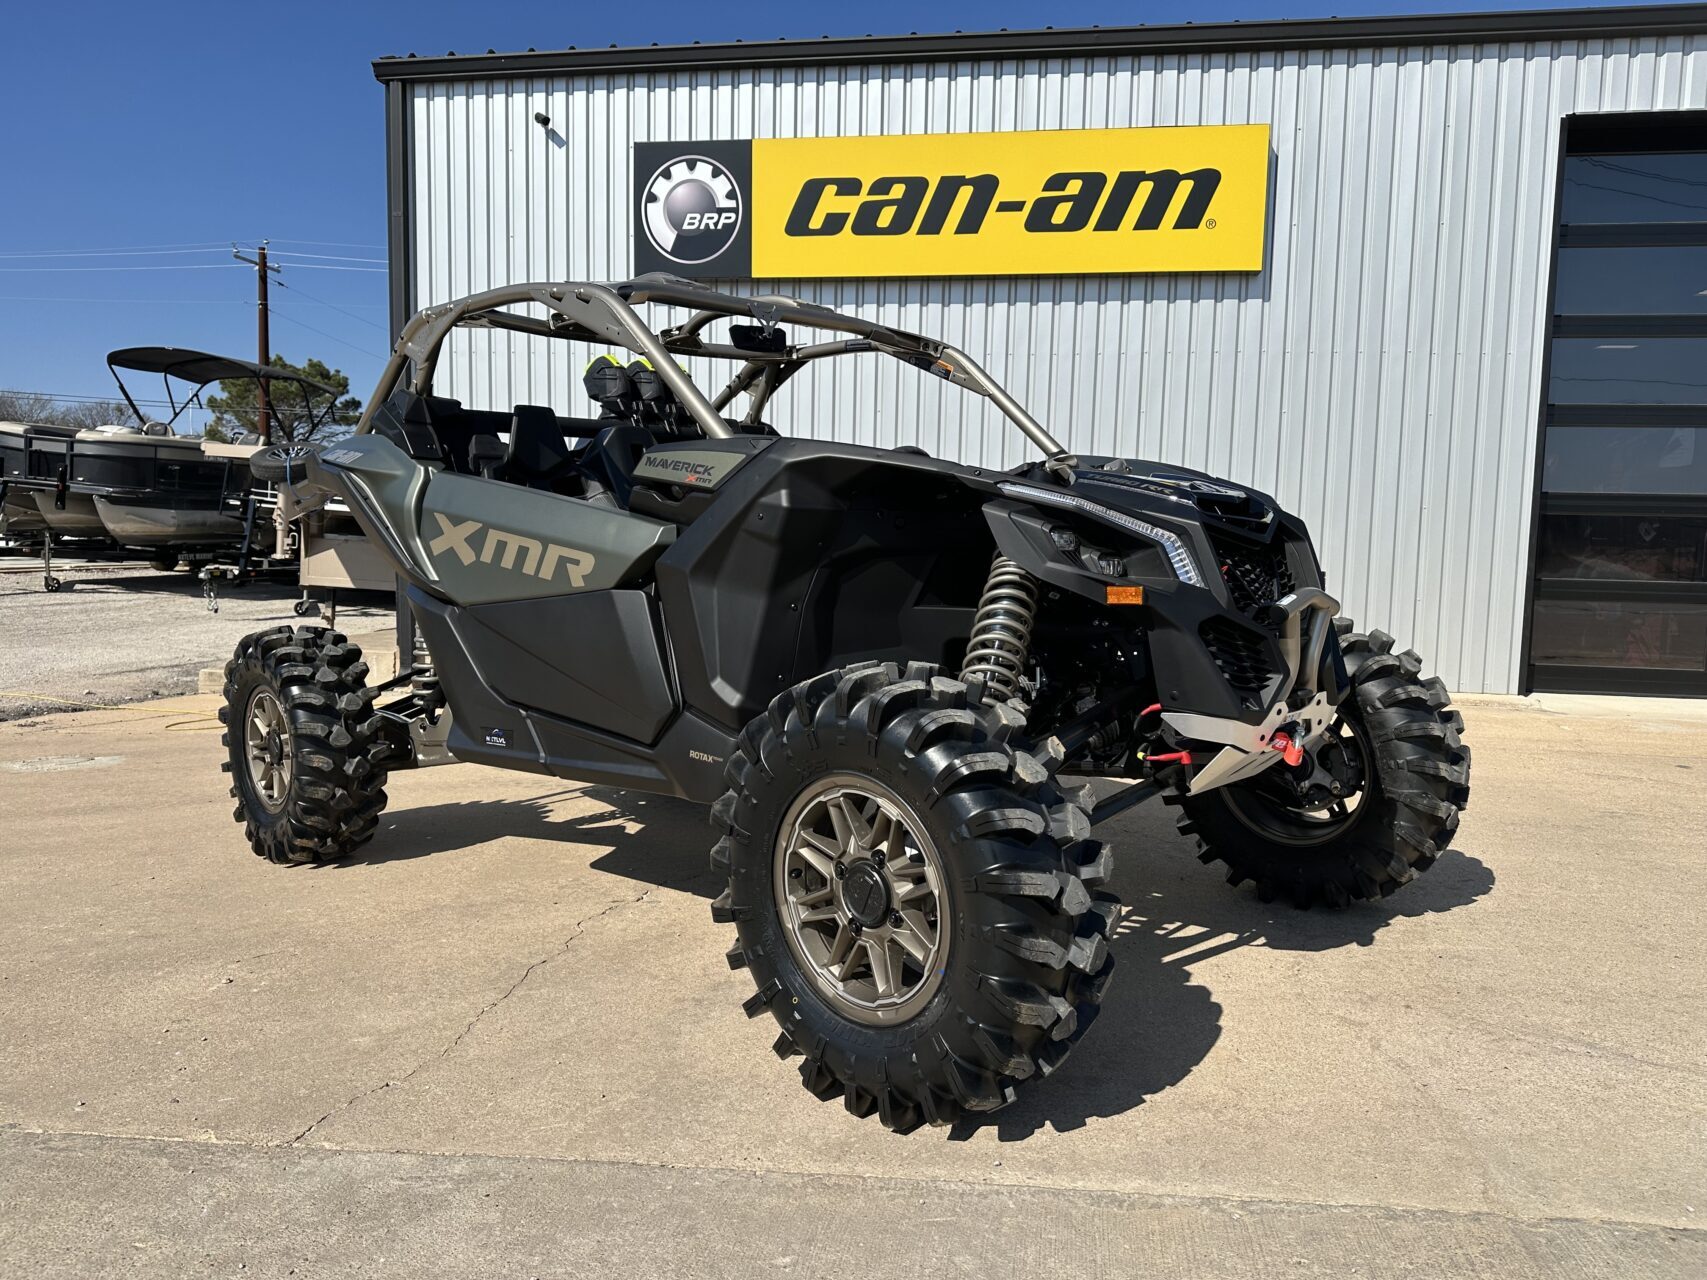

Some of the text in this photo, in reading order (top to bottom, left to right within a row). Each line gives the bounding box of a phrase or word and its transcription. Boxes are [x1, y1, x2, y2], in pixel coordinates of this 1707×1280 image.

[784, 167, 1222, 238] can-am
[682, 210, 737, 231] BRP
[645, 456, 715, 476] MAVERICK
[689, 749, 714, 763] ROTAX
